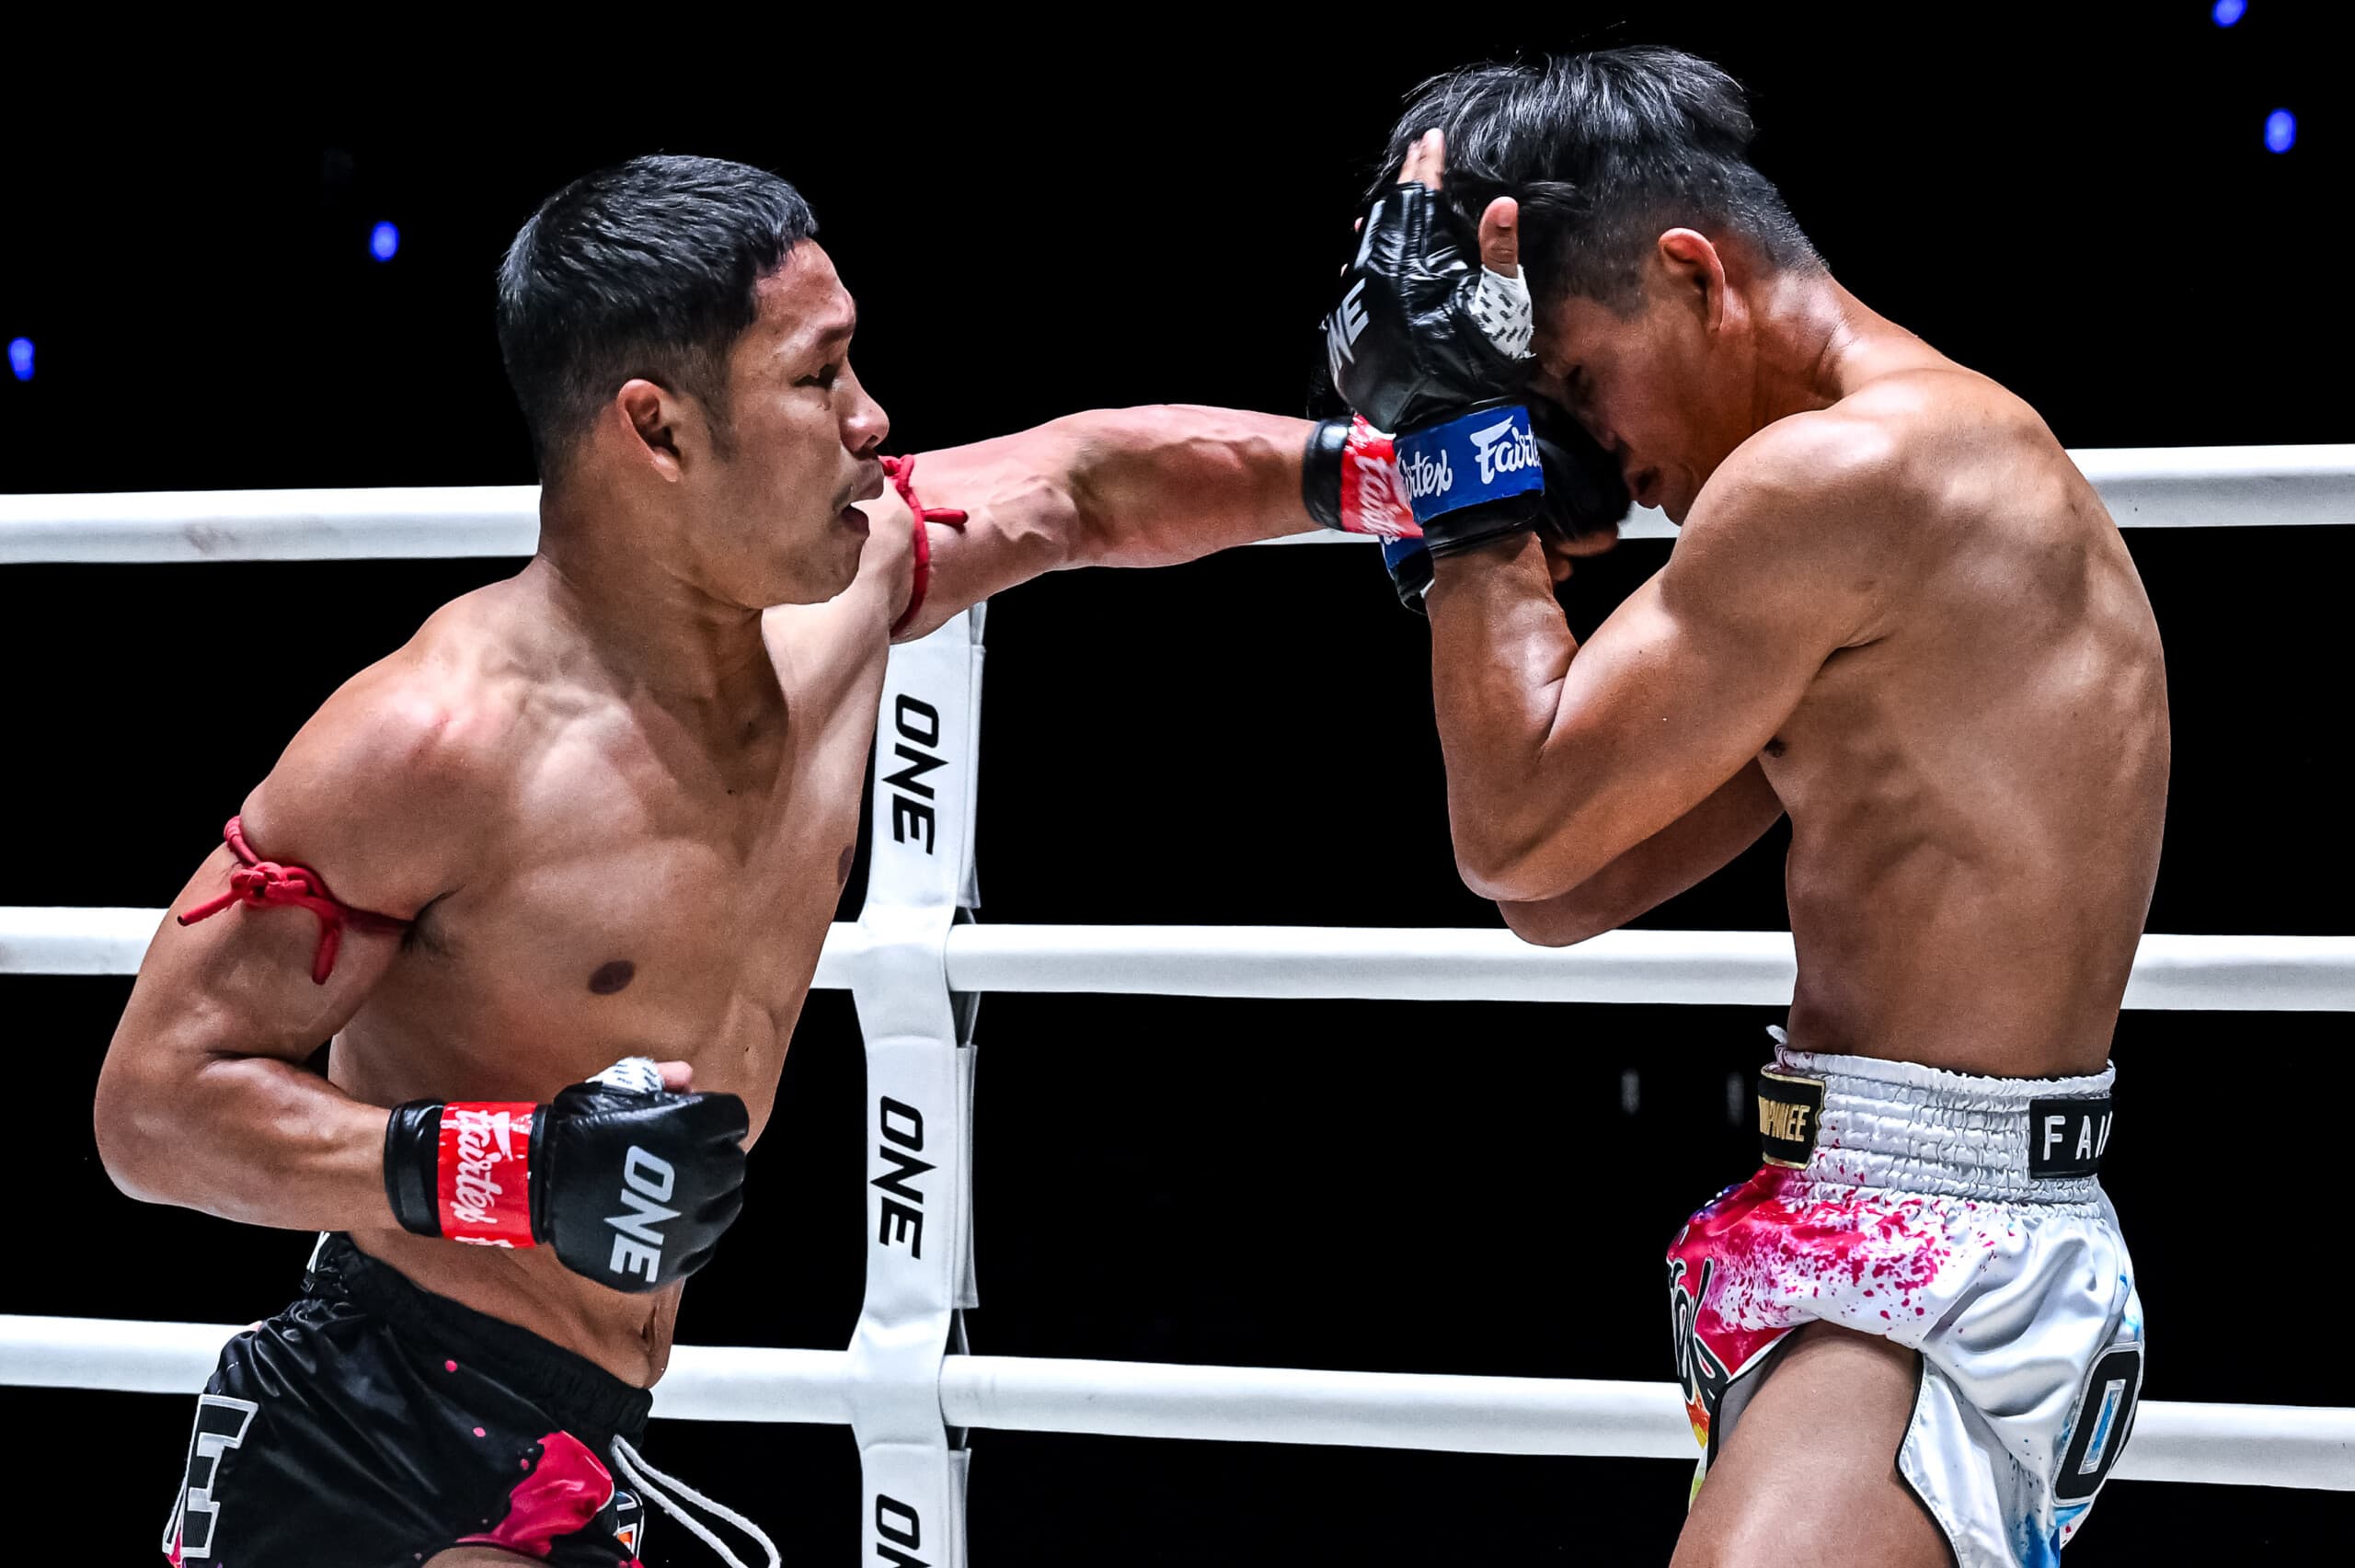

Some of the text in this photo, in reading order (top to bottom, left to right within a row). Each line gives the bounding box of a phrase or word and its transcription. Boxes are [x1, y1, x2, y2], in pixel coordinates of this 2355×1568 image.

[1327, 277, 1370, 391] NE
[880, 693, 949, 855] ONE
[454, 1109, 513, 1225] Fairtex
[603, 1145, 682, 1283] ONE
[869, 1095, 937, 1260] ONE
